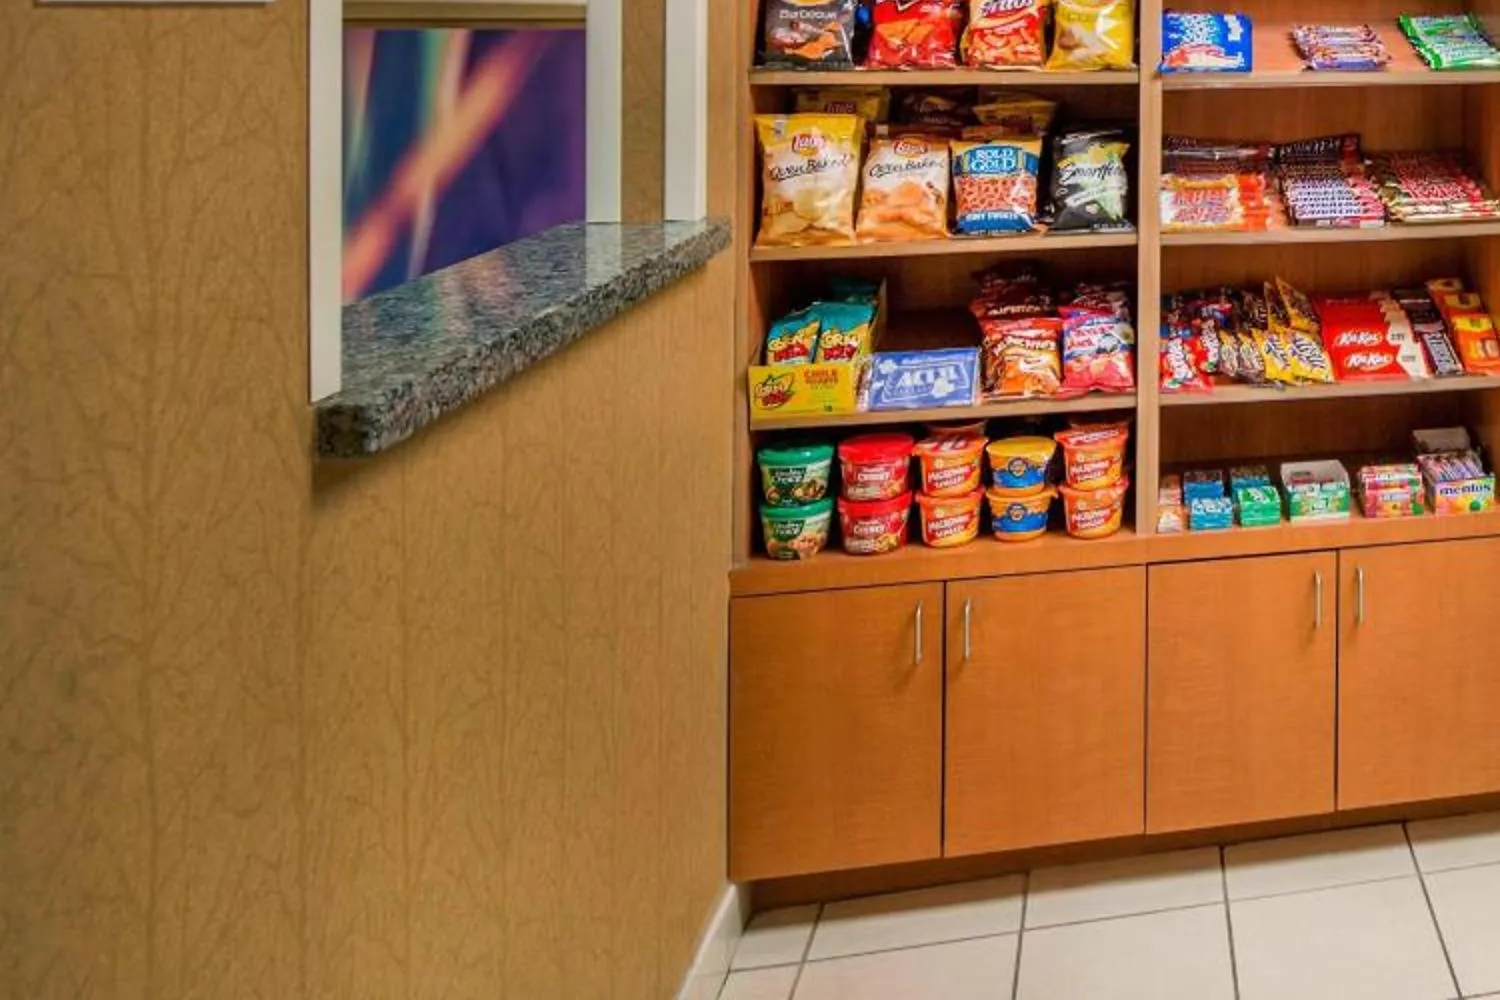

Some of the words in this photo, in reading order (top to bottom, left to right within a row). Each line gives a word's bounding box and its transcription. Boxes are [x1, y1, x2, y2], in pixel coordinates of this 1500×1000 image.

[975, 149, 1014, 159] ROLD
[970, 157, 1016, 172] GOLD
[1440, 483, 1491, 495] mentos
